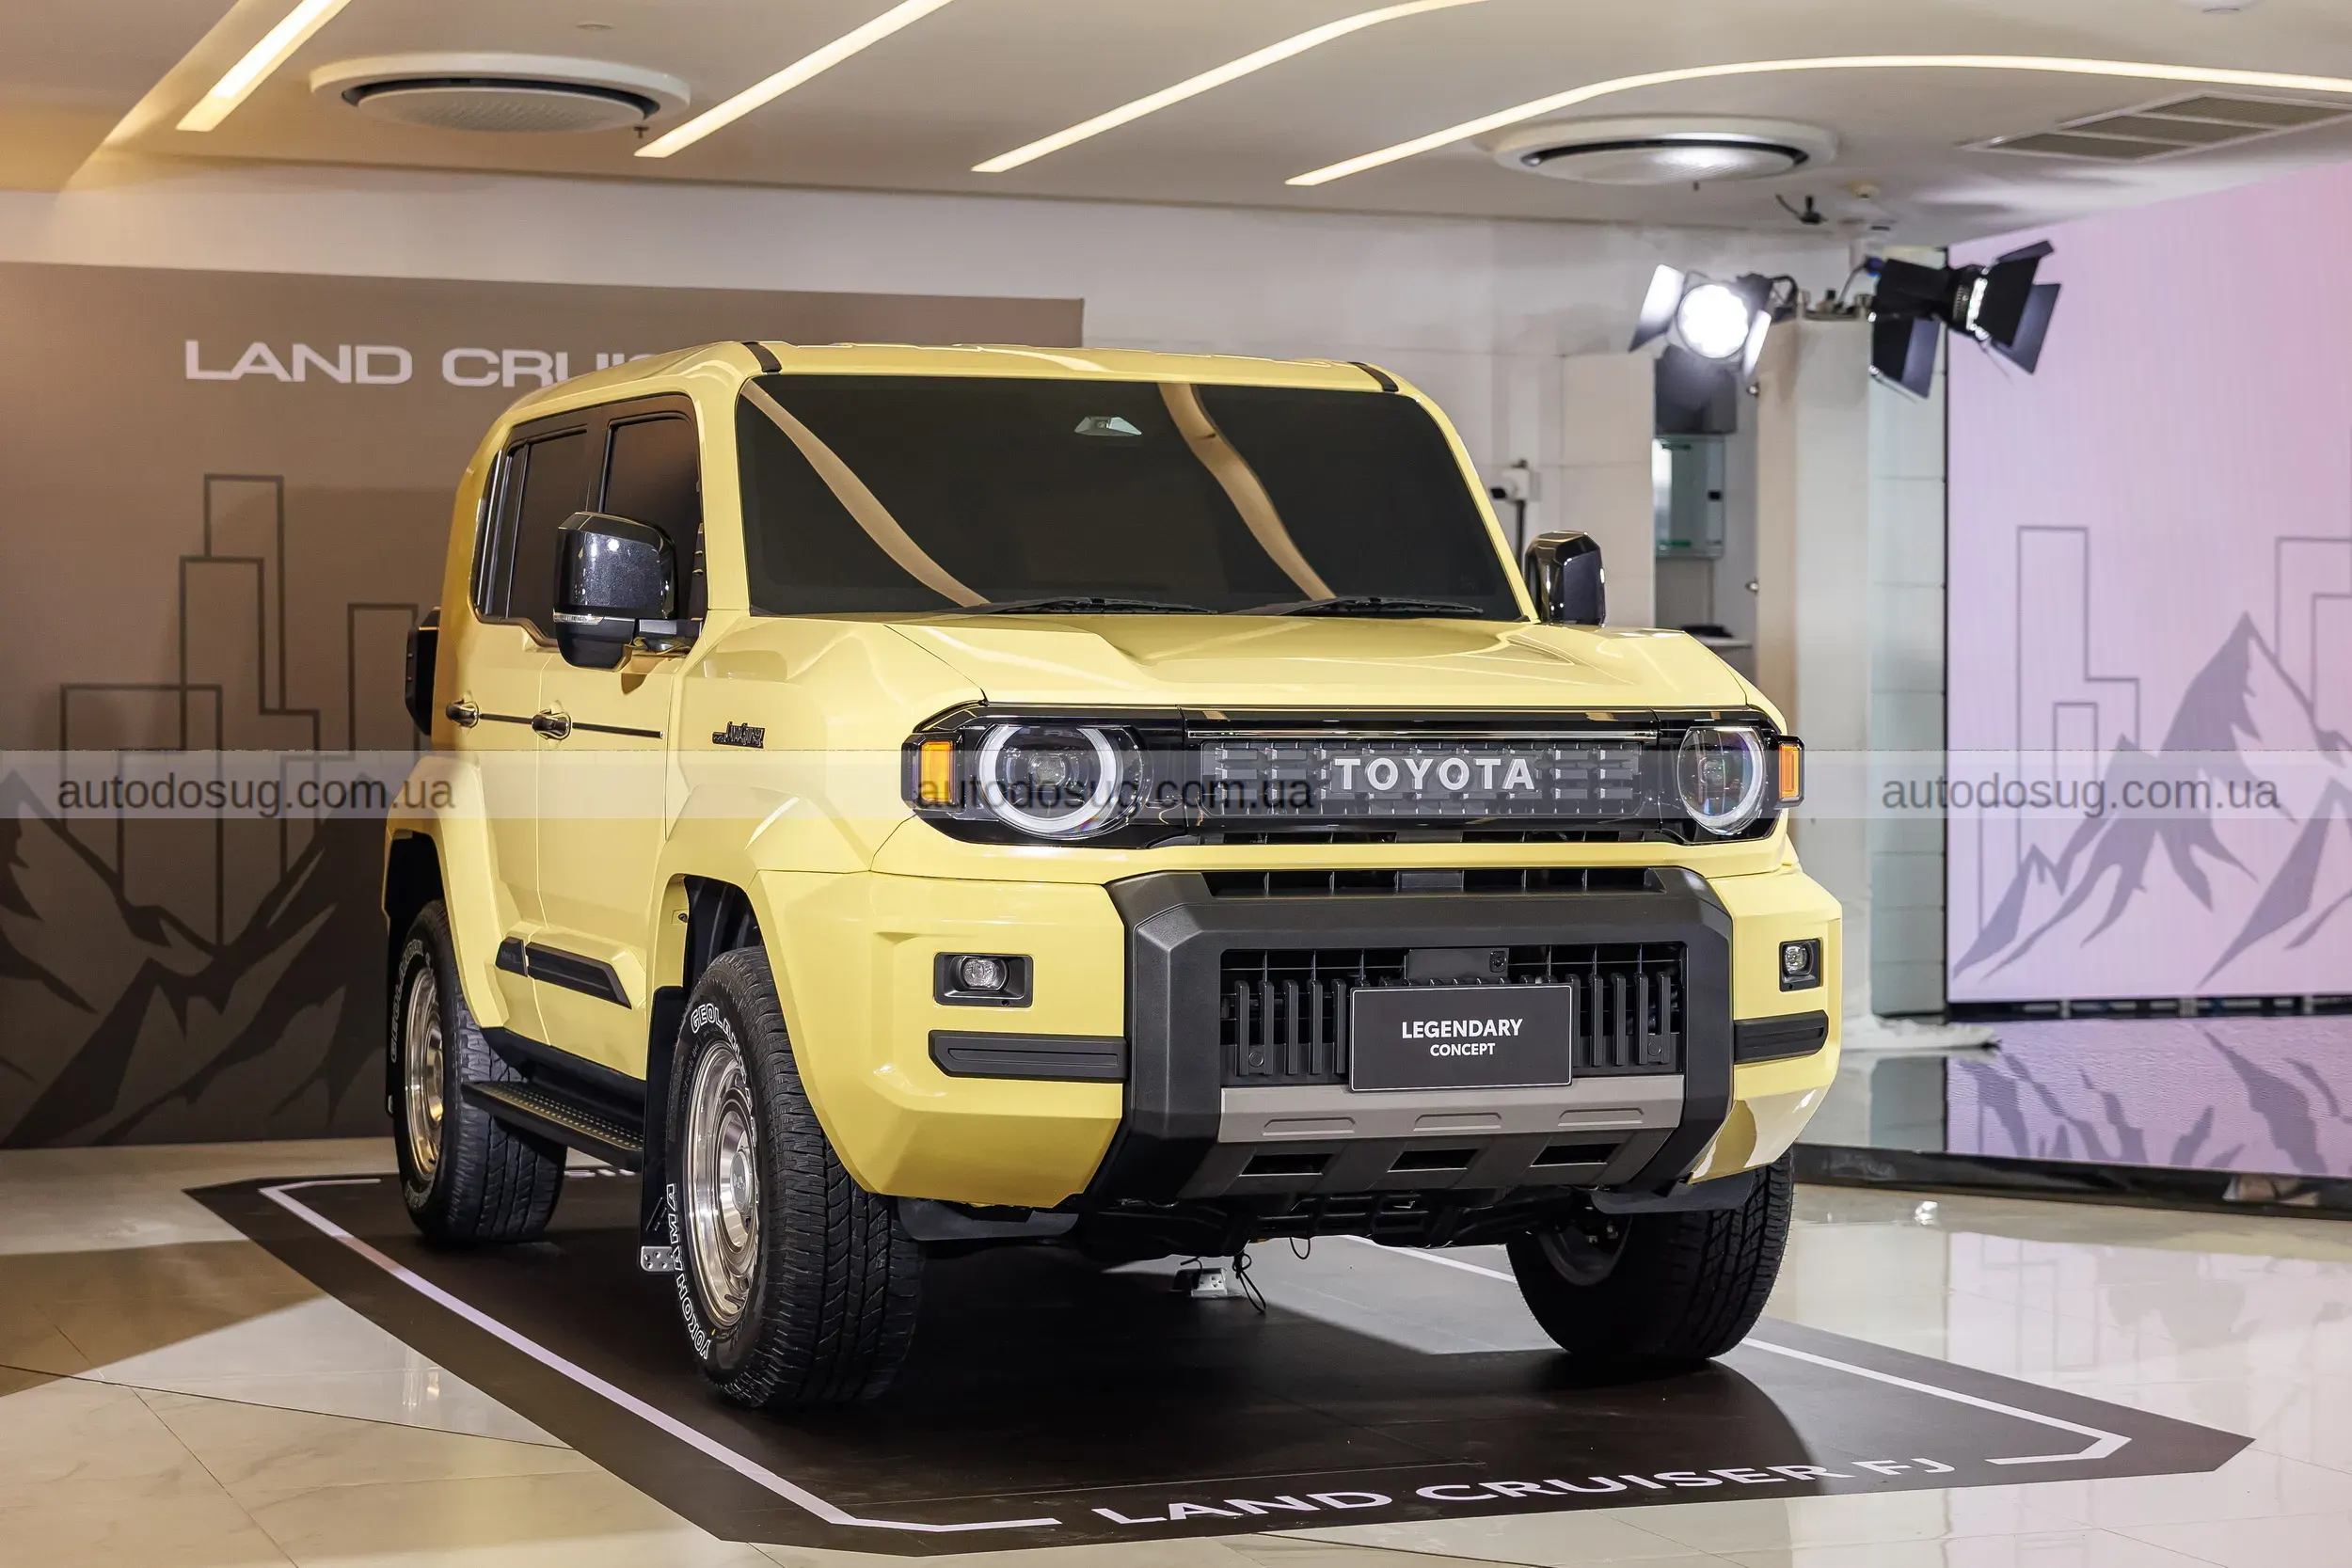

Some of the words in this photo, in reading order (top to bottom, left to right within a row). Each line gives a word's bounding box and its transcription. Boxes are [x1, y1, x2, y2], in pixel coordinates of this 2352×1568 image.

[184, 340, 413, 385] LAND
[1333, 757, 1535, 791] TOYOTA
[1401, 1018, 1523, 1039] LEGENDARY
[1429, 1042, 1496, 1057] CONCEPT
[666, 1182, 711, 1360] YOKOHAMA
[1090, 1491, 1393, 1525] LAND
[1415, 1464, 1858, 1500] CRUISER
[1851, 1456, 1956, 1475] FJ
